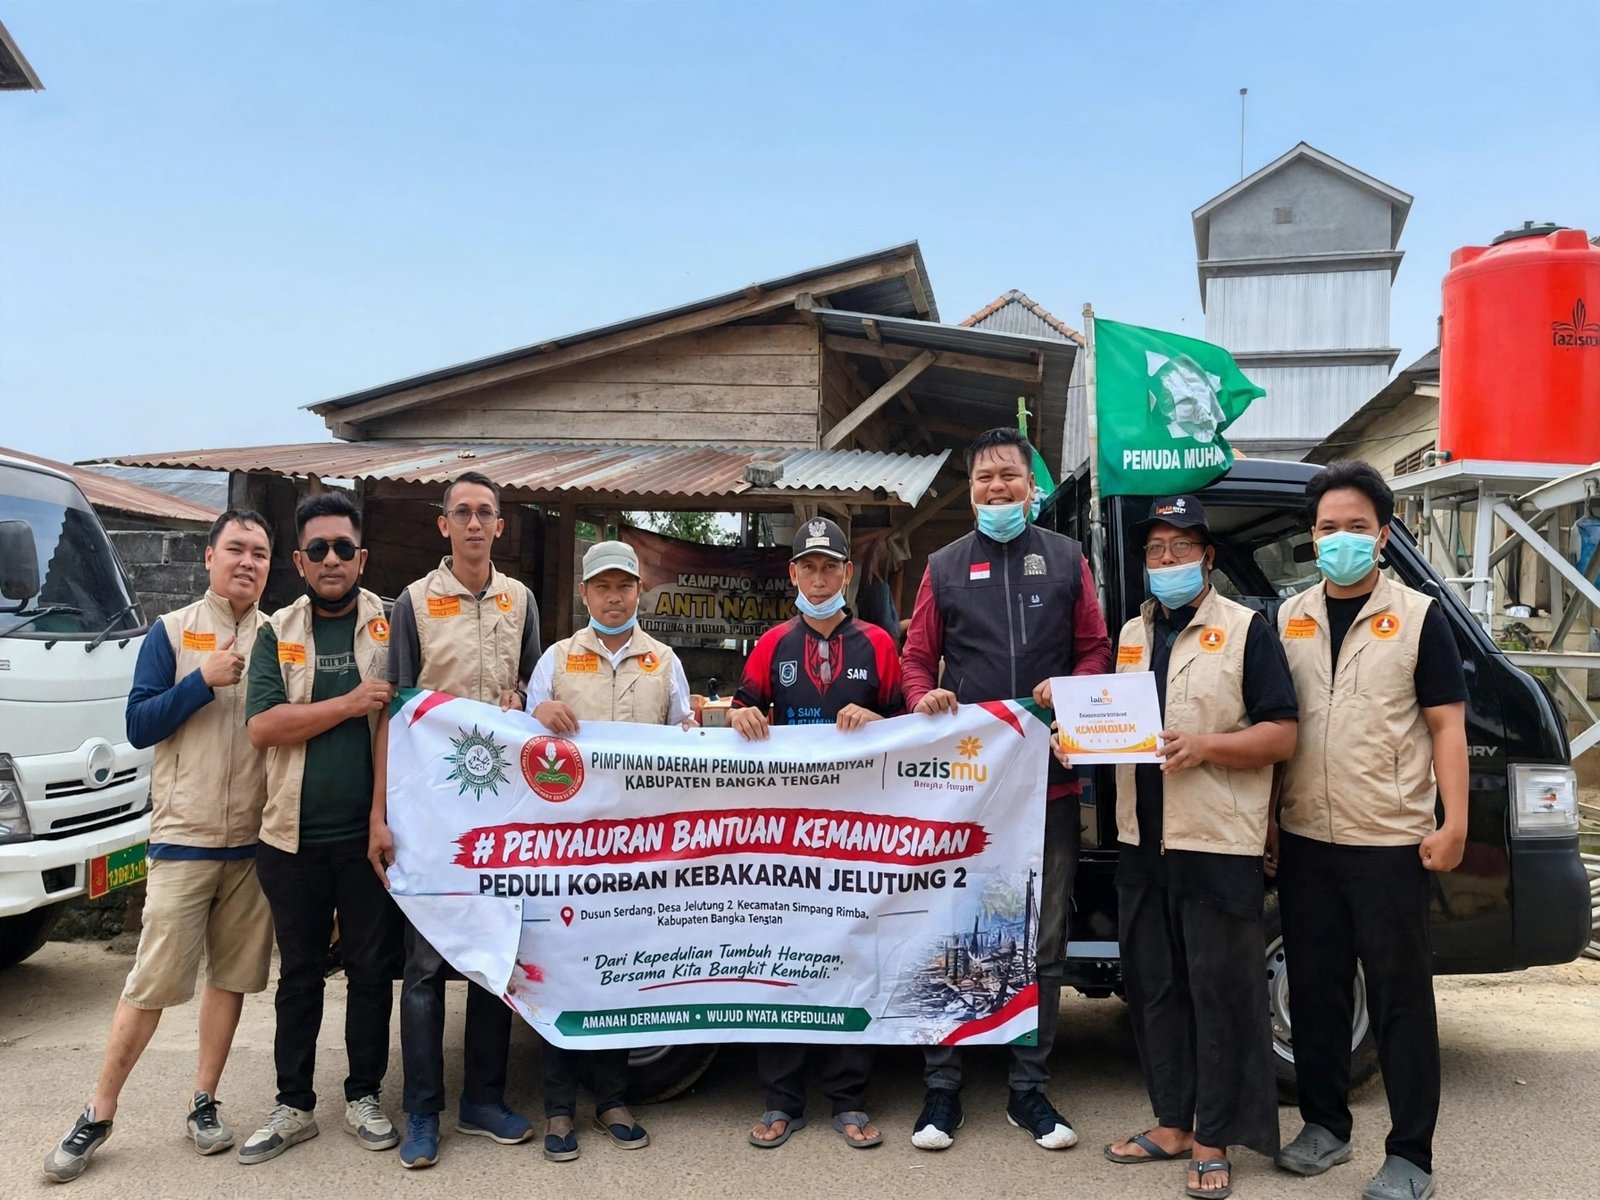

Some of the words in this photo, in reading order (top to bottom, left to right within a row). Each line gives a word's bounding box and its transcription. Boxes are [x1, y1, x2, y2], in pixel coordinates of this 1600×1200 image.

[1123, 449, 1181, 470] PEMUDA
[655, 592, 715, 619] ANTI
[721, 595, 797, 620] NANK
[846, 668, 868, 681] SAN
[591, 751, 653, 771] PIMPINAN
[657, 755, 708, 773] DAERAH
[712, 758, 765, 775] PEMUDA
[768, 758, 875, 775] MUHAMMADIYAH
[897, 756, 988, 783] lazismu
[625, 774, 711, 791] KABUPATEN
[715, 776, 777, 788] BANGKA
[781, 773, 841, 786] TENGAH
[502, 822, 664, 863] PENYALURAN
[671, 814, 786, 852] BANTUAN
[792, 815, 970, 857] KEMANUSIAAN
[479, 873, 560, 897] PEDULI
[568, 870, 667, 896] KORBAN
[675, 863, 821, 890] KEBAKARAN
[828, 868, 946, 895] JELUTUNG
[953, 867, 967, 888] 2
[581, 909, 611, 920] Dusun
[613, 904, 656, 918] Serdang,
[657, 902, 682, 914] Desa
[684, 900, 725, 913] Jelutung
[727, 900, 734, 910] 2
[737, 900, 790, 912] Kecamatan
[792, 902, 833, 918] Simpang
[657, 914, 709, 928] Kabupaten
[710, 912, 746, 926] Bangka
[719, 943, 772, 960] Tumbuh
[600, 968, 667, 986] Bersama
[672, 962, 702, 979] Kita
[708, 960, 768, 979] Bangkit
[582, 1014, 627, 1029] AMANAH
[630, 1010, 690, 1026] DERMAWAN
[706, 1009, 744, 1023] WUJUD
[746, 1009, 778, 1023] NYATA
[781, 1010, 845, 1026] KEPEDULIAN
